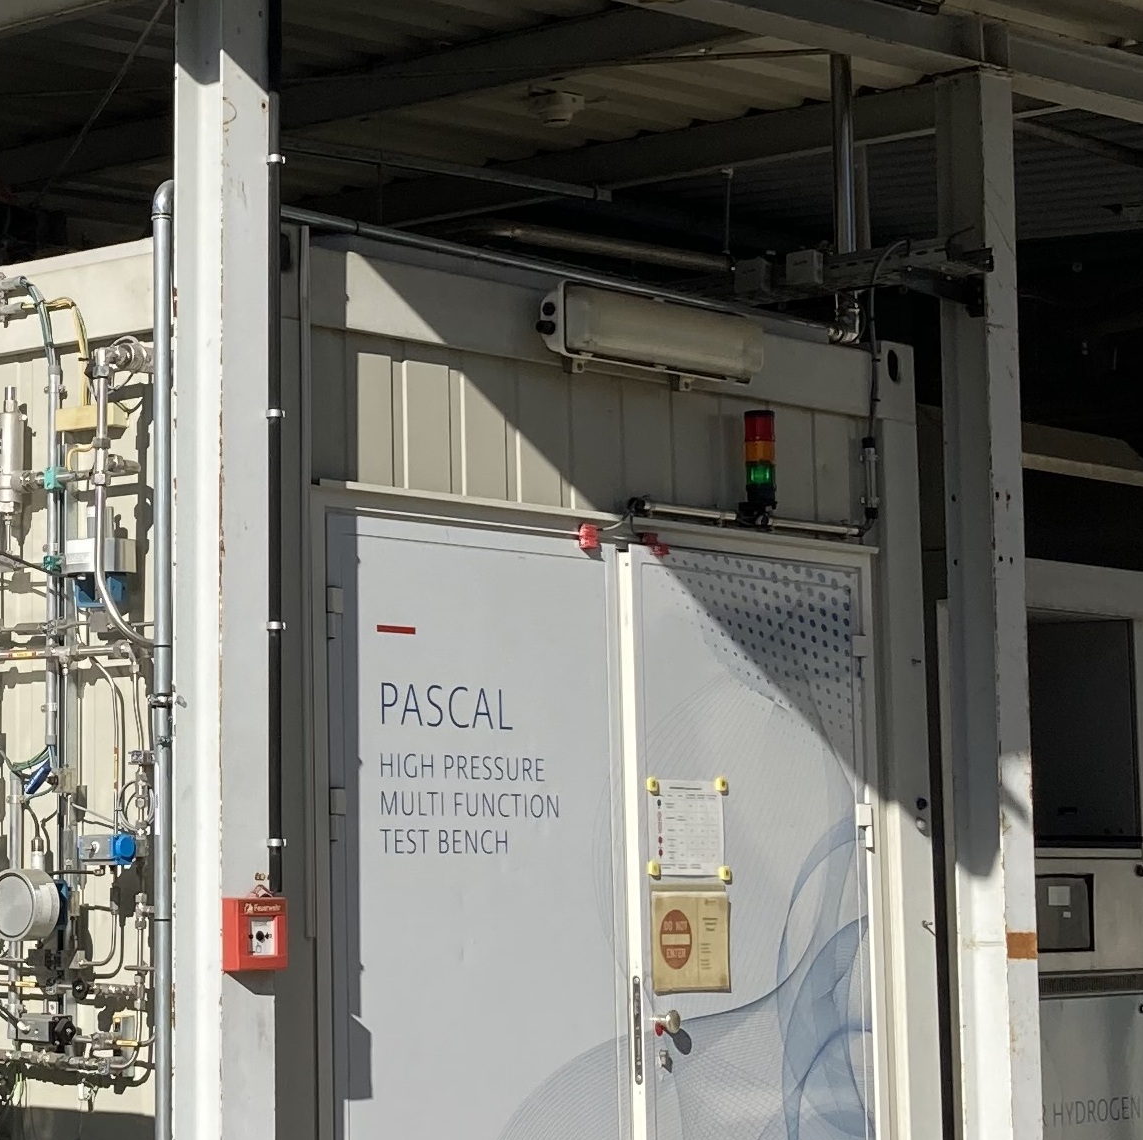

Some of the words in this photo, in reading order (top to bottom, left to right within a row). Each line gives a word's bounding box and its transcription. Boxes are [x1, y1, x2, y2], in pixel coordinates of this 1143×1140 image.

[380, 681, 514, 731] PASCAL
[380, 752, 434, 779] HIGH
[444, 754, 546, 782] PRESSURE
[380, 790, 444, 817] MULTI
[454, 792, 560, 818] FUNCTION
[379, 828, 430, 855] TEST
[438, 829, 508, 855] BENCH
[1052, 1095, 1141, 1127] HYDROGEN
